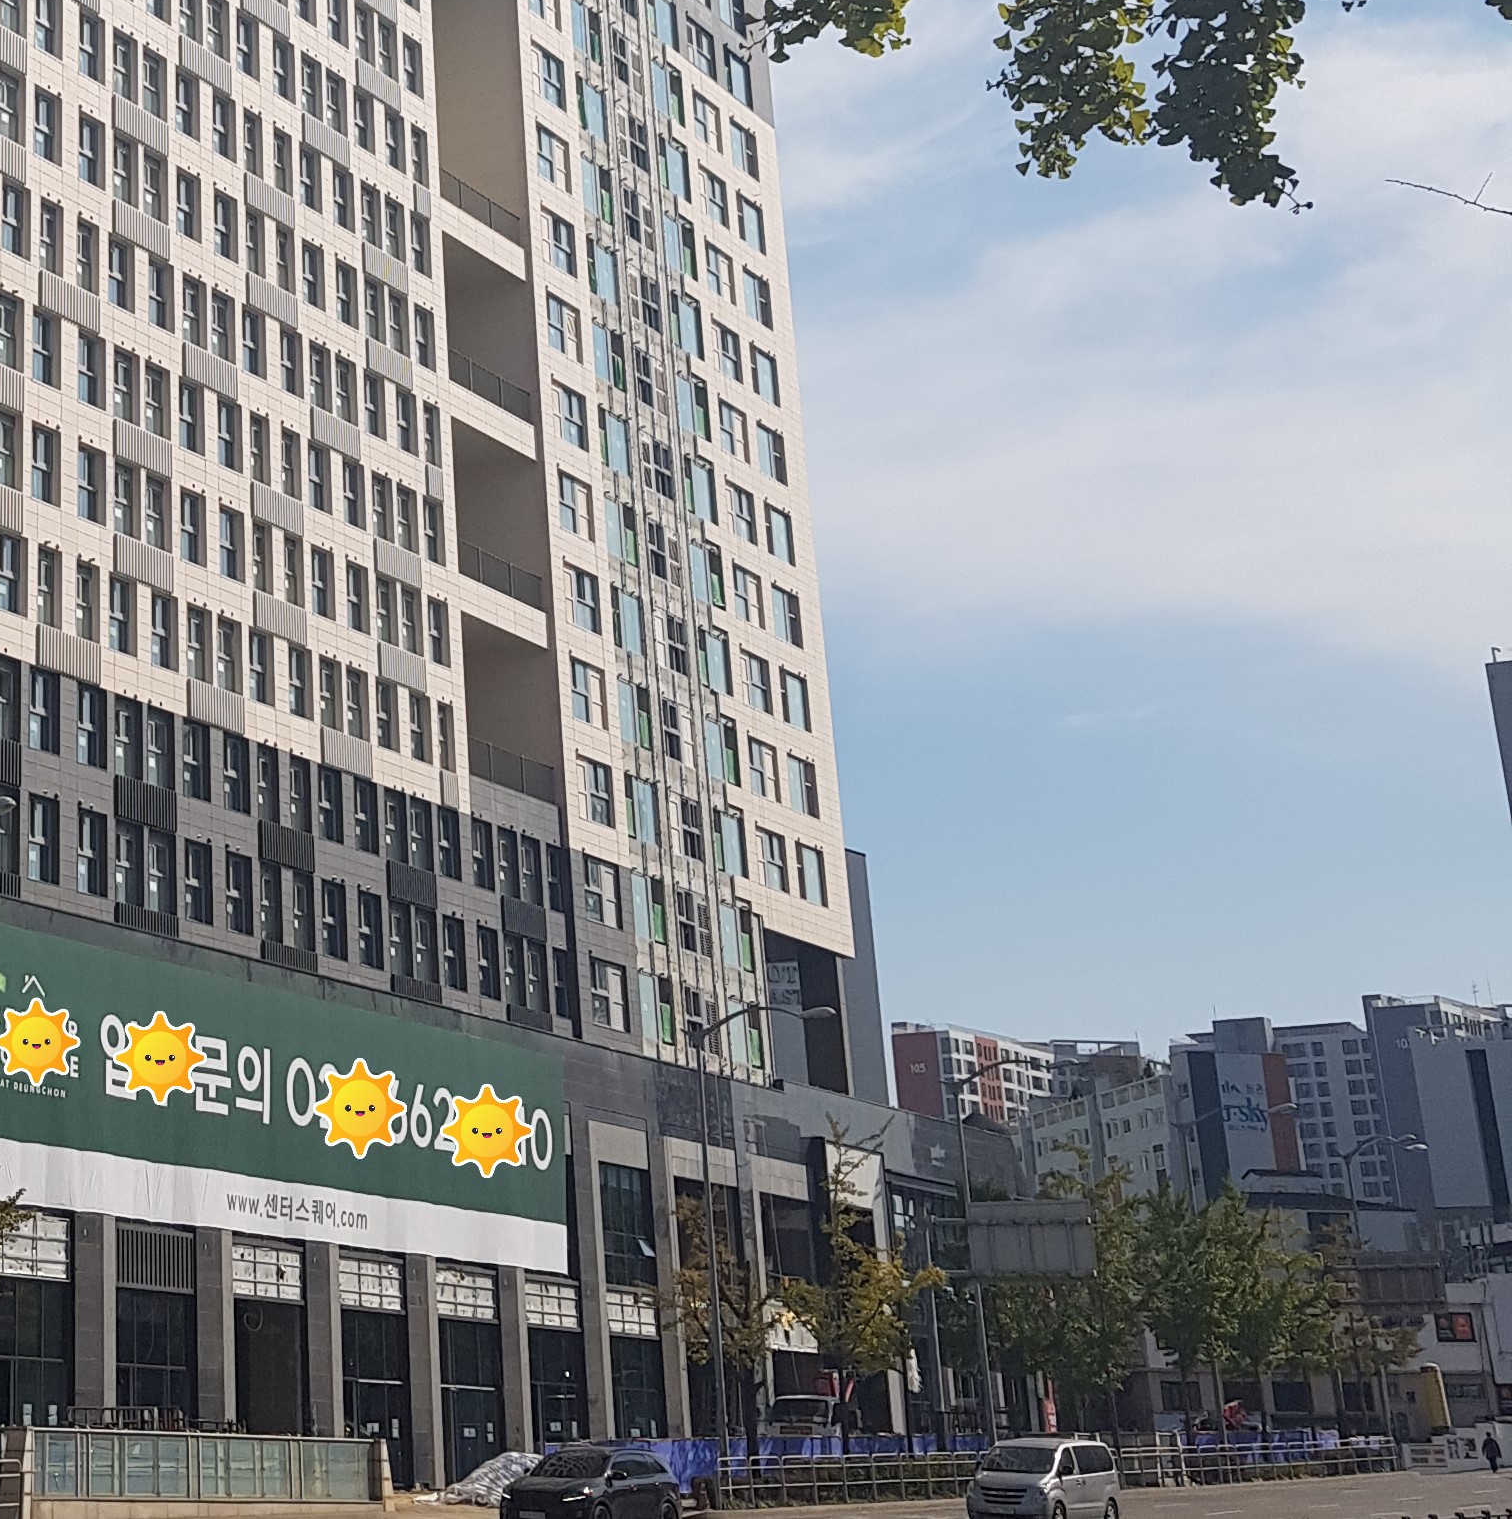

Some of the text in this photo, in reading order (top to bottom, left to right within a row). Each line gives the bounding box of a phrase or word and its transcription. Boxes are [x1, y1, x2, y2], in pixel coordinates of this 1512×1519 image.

[0, 1078, 10, 1088] AT
[100, 1014, 271, 1125] 입문의
[226, 1193, 368, 1230] www.센터스퀘어.com
